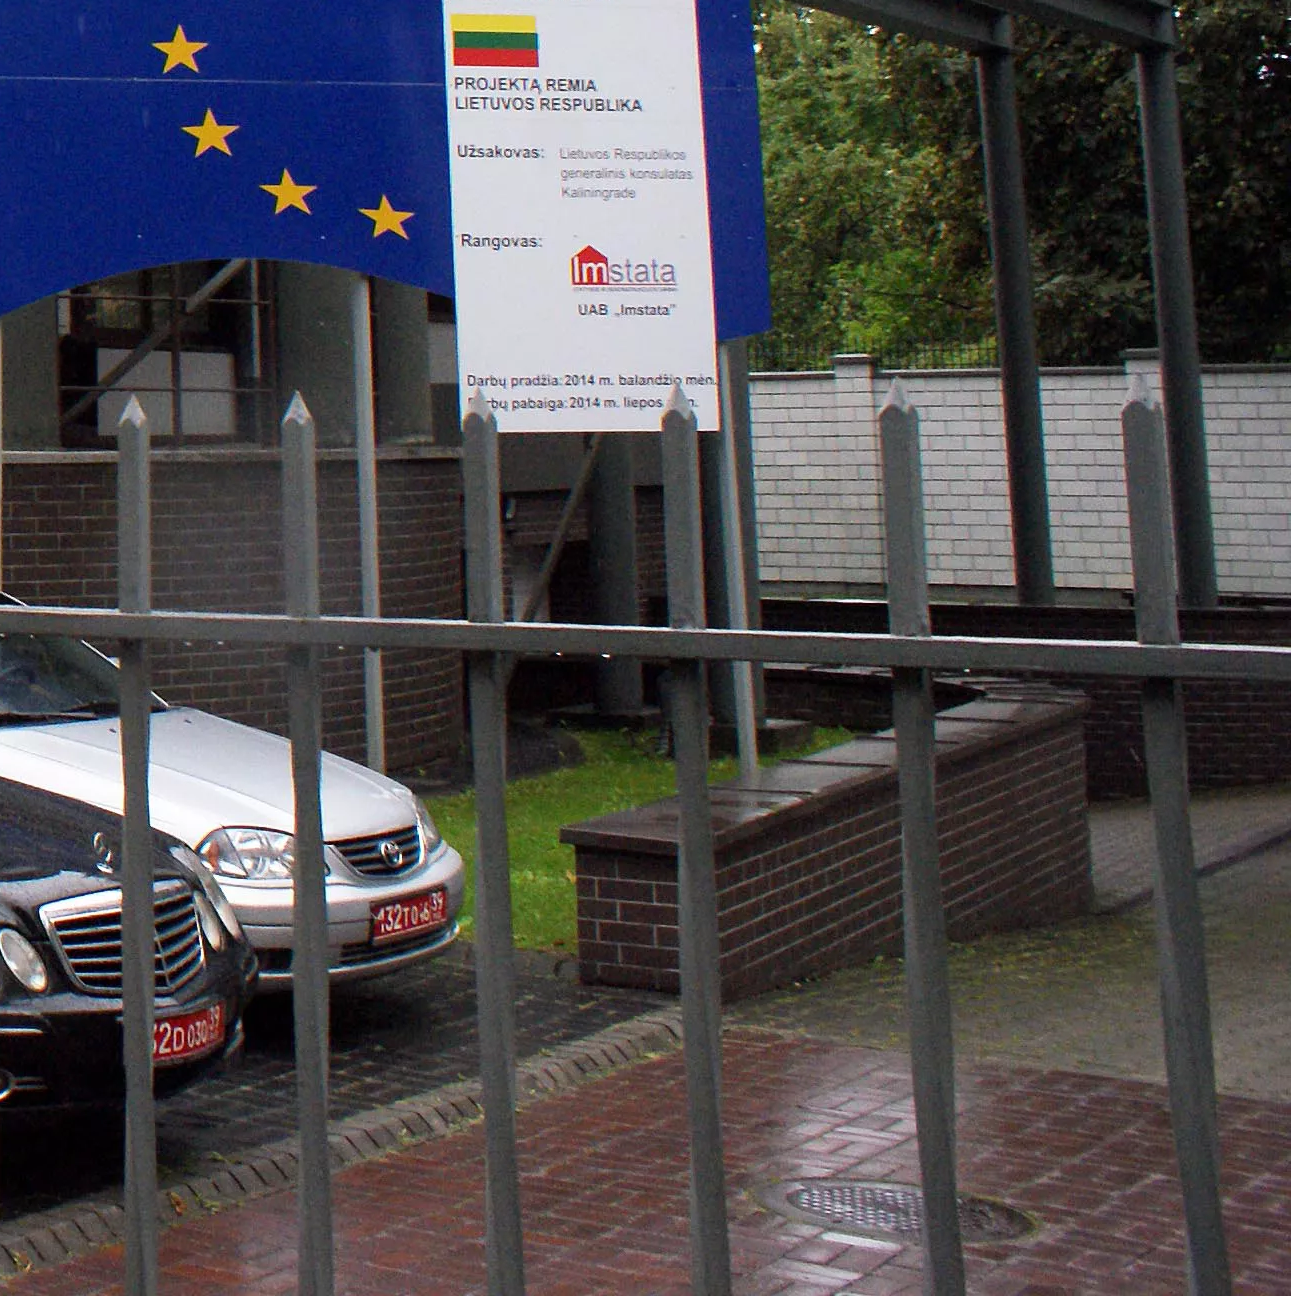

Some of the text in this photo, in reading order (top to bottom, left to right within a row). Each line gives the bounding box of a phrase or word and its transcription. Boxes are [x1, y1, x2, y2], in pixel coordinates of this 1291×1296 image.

[454, 77, 597, 94] PROJEKTĄ REMIA
[454, 97, 643, 113] LIETUVOS RESPUBLIKA
[457, 145, 687, 163] Užsakovas: Lietuvos Respublikos
[560, 167, 694, 181] generalinis konsulatas
[561, 186, 636, 201] Kaliningrade
[461, 234, 543, 251] Rangovas:
[573, 255, 676, 284] Imstata
[577, 304, 609, 316] UAB
[467, 374, 717, 389] Darbų pradžia: 2014 m. balandžio mėn.
[511, 396, 568, 412] pabaiga:
[569, 397, 601, 409] 2014
[604, 399, 619, 409] m.
[623, 396, 663, 411] liepos
